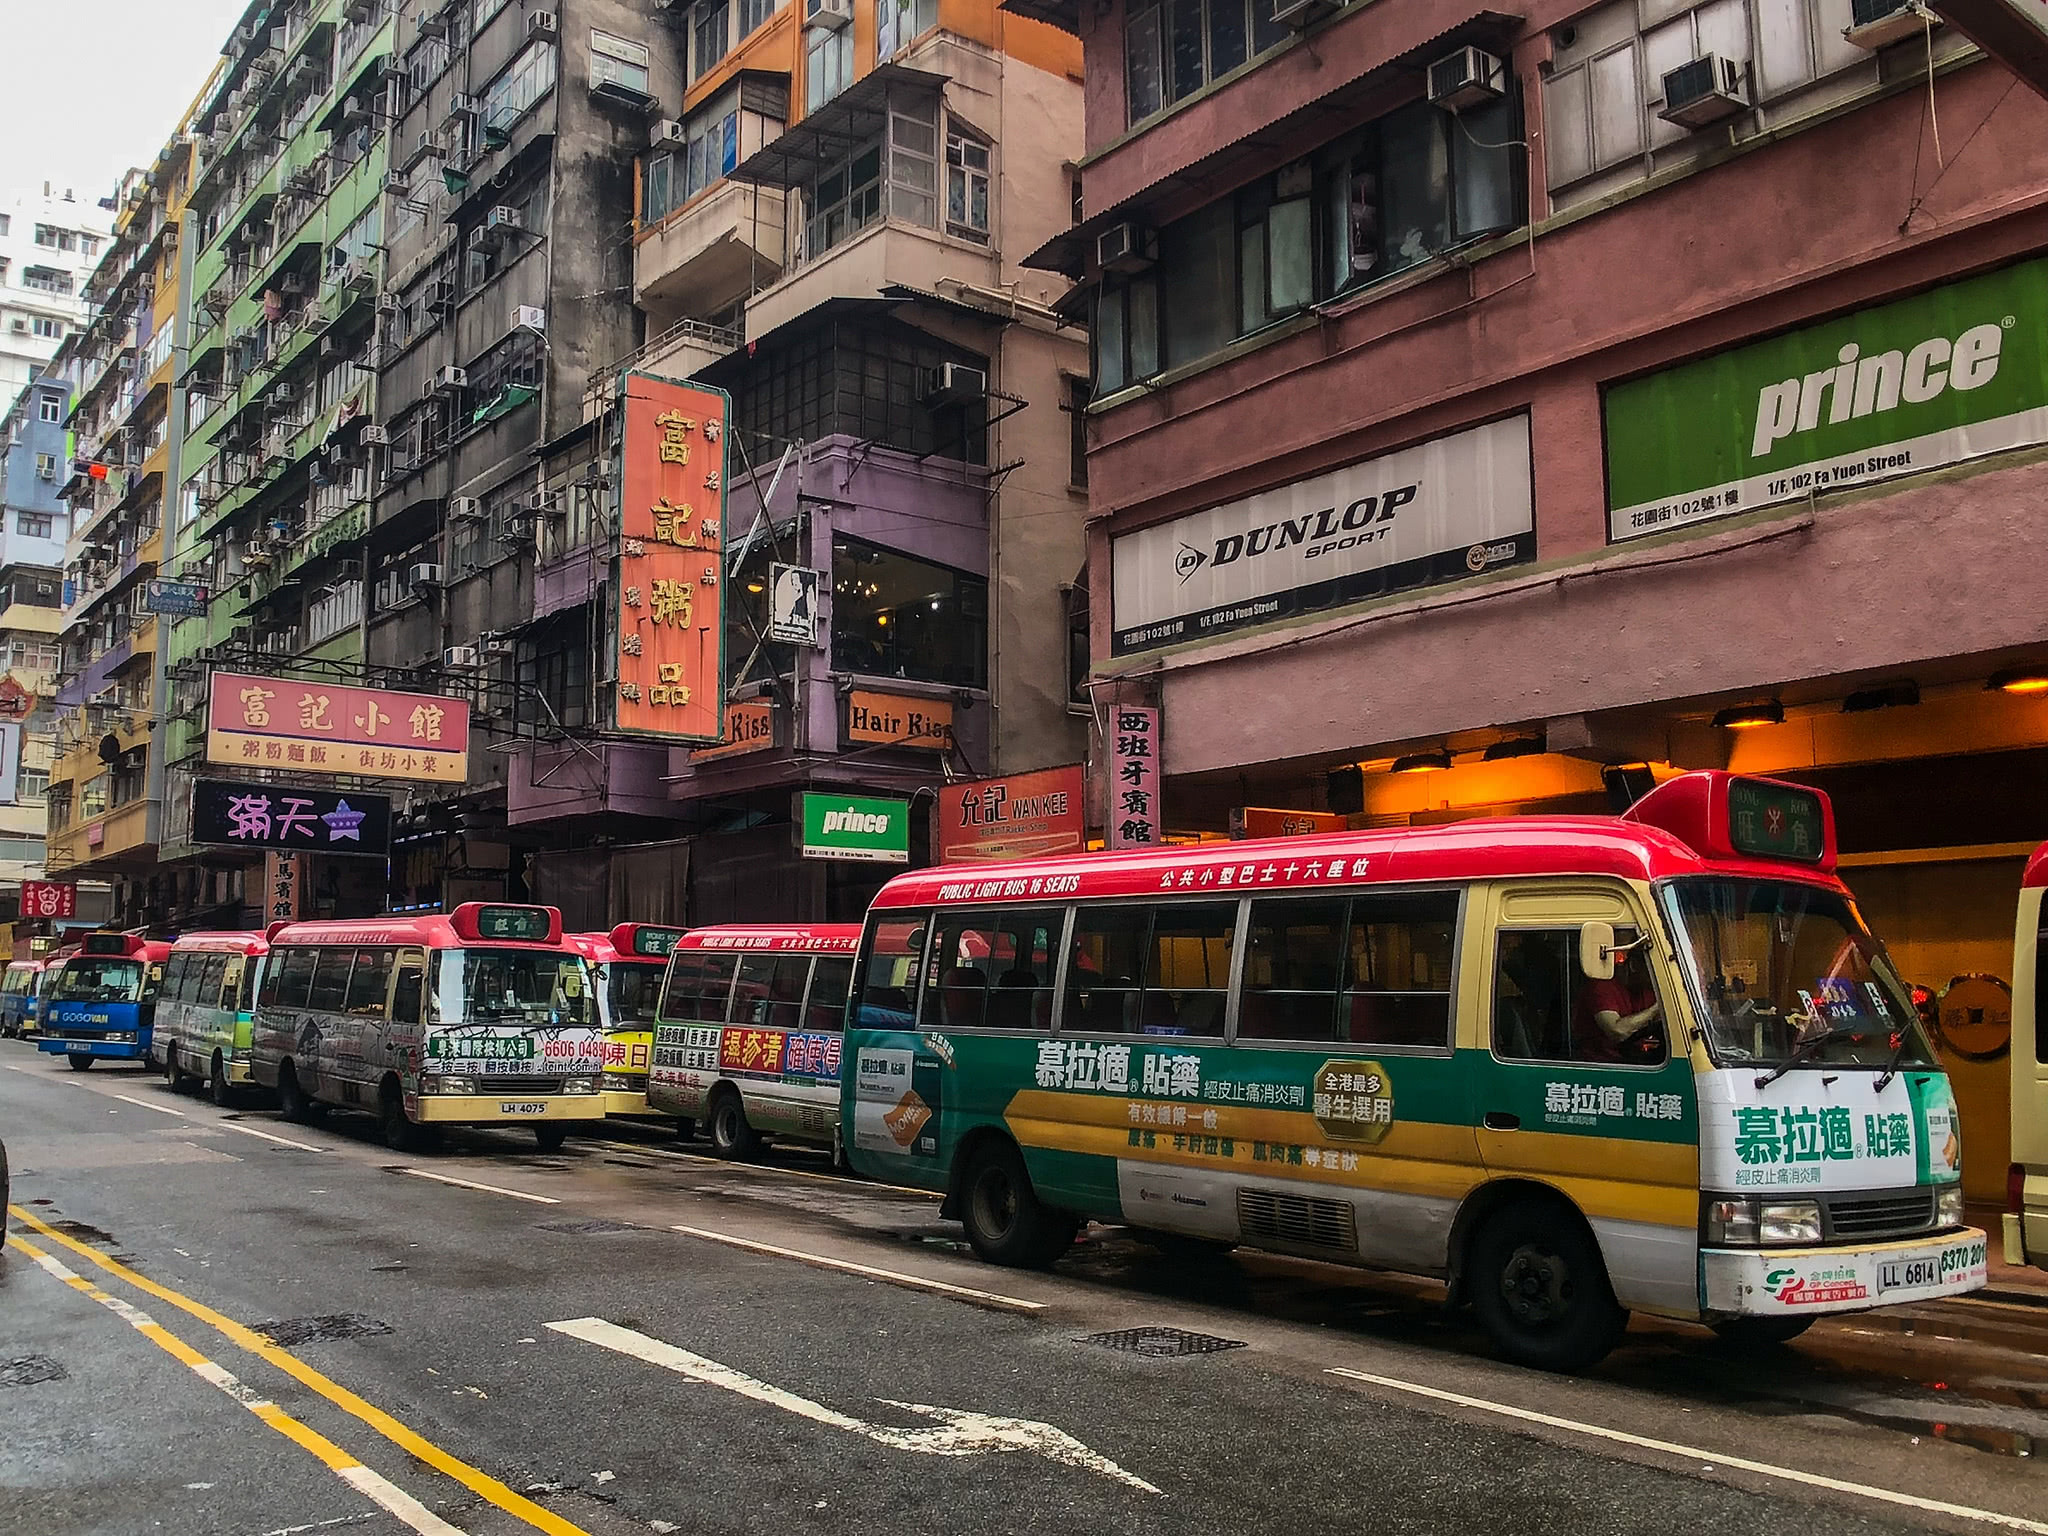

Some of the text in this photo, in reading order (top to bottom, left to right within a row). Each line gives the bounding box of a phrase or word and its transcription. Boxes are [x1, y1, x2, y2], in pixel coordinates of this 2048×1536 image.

[1791, 473, 1812, 490] 102
[1815, 470, 1830, 486] Fa
[1832, 461, 1866, 482] Yuen
[1868, 450, 1912, 473] Street
[1210, 484, 1418, 568] DUNLOP
[649, 408, 697, 707] 富記粥品
[1305, 526, 1392, 560] SPORT
[1226, 610, 1234, 622] Fa
[1254, 600, 1279, 615] Street
[238, 685, 446, 743] 富記小館
[730, 711, 770, 744] Kiss
[852, 706, 901, 735] Hair
[242, 739, 438, 774] 粥粉麵飯 街坊小菜
[1116, 711, 1153, 843] 西班牙賓館
[227, 793, 319, 841] 滿天
[821, 805, 889, 835] prince
[960, 784, 1008, 828] 允記
[1011, 791, 1068, 820] WAN KEE
[937, 875, 1081, 901] PUBLIC LIGHT BUS 16 SEATS
[1159, 858, 1370, 888] 公共小型巴士十六座位
[61, 1011, 109, 1024] GOGOVAN
[544, 1040, 575, 1057] 6606
[1141, 1053, 1201, 1098] 貼藥
[1324, 1072, 1381, 1094] 全港最多
[1203, 1079, 1305, 1106] 經皮止痛消炎劑
[1313, 1092, 1391, 1124] 醫生選用
[1544, 1081, 1683, 1121] 慕拉適 貼藥
[501, 1103, 546, 1114] LH 4075
[1864, 1112, 1911, 1159] 貼藥
[1734, 1167, 1821, 1186] 經皮止痛消炎劑
[1882, 1265, 1901, 1288] LL
[1905, 1262, 1934, 1285] 6814
[1940, 1246, 1969, 1273] 6370
